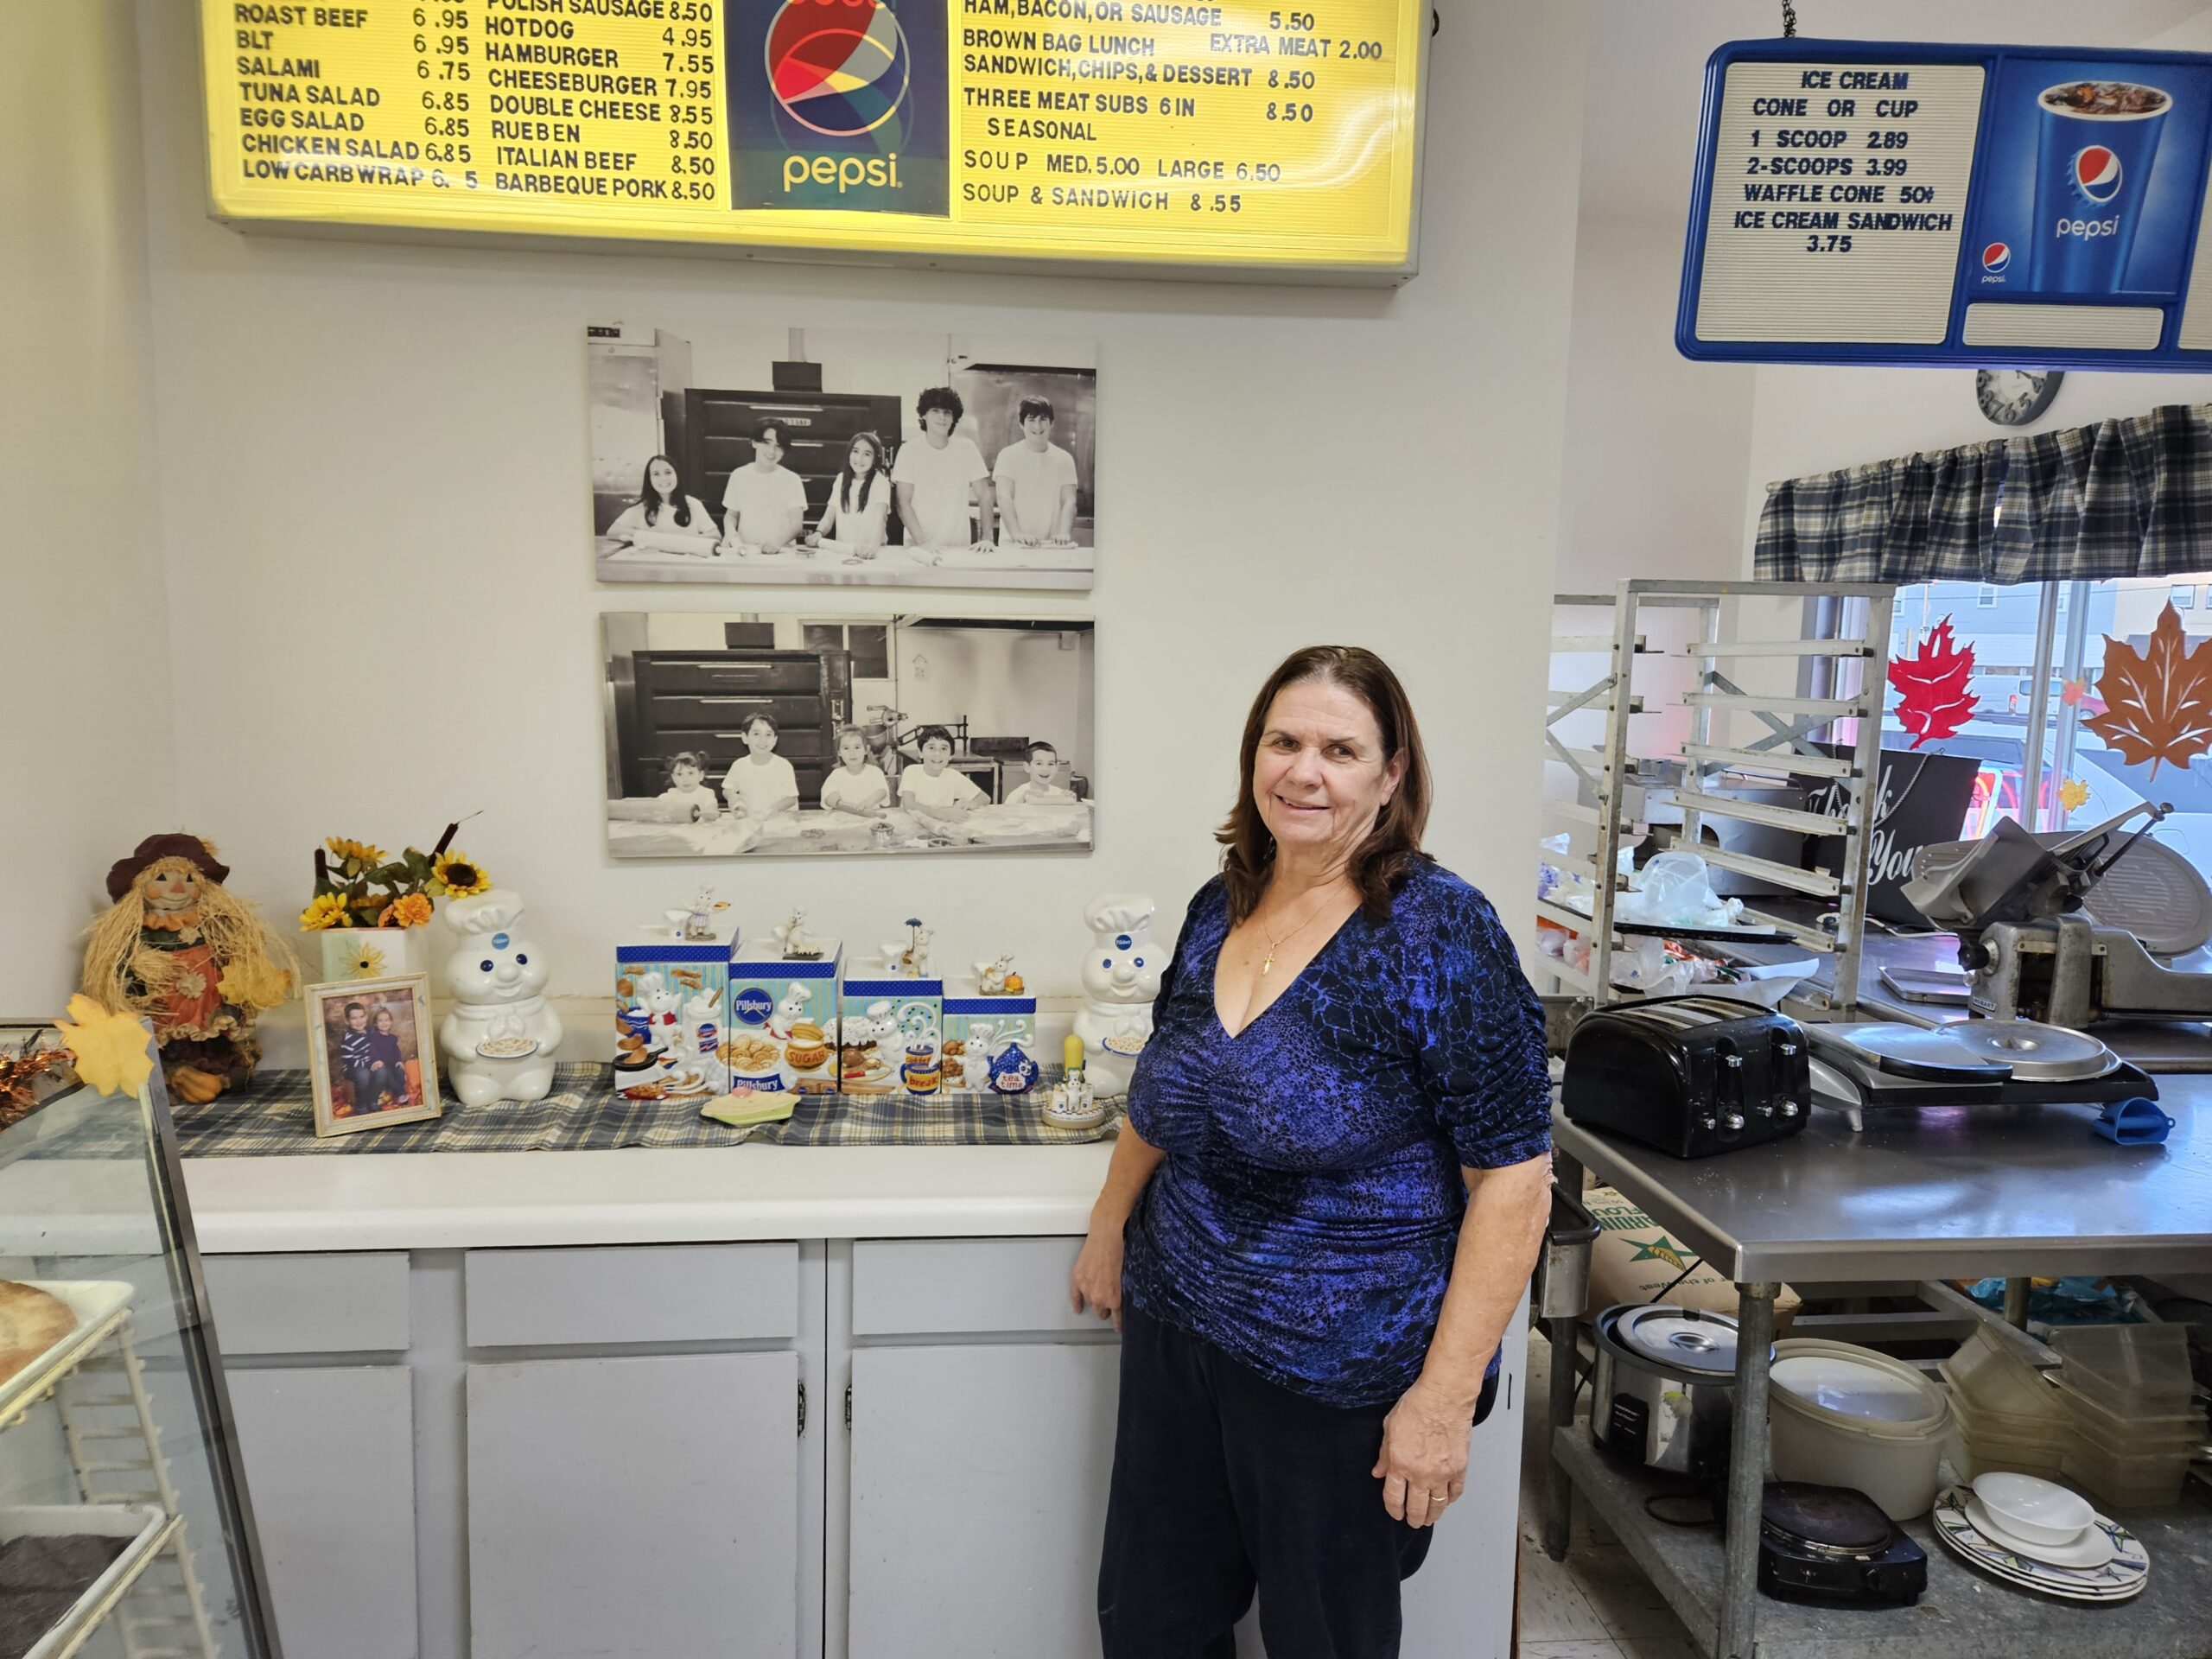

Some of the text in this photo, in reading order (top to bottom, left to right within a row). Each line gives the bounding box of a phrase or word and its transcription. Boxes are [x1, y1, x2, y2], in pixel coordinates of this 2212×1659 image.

[234, 3, 307, 25] ROAST
[314, 8, 368, 28] BEEF
[569, 0, 664, 19] SAUSAGE
[669, 1, 713, 22] 8.50
[1131, 3, 1221, 26] SAUSAGE
[1269, 11, 1314, 31] 5.50
[236, 29, 274, 50] BLT
[485, 16, 711, 48] HOTDOG 4.95
[963, 29, 1154, 56] BROWN BAG LUNCH
[486, 41, 714, 74] HAMBURGER 7.55
[1211, 33, 1382, 60] EXTRA MEAT 2.00
[236, 56, 320, 78] SALAMI
[1163, 64, 1252, 86] DESSERT
[1268, 69, 1314, 89] 8.50
[1801, 70, 1909, 90] ICE CREAM
[239, 82, 469, 111] TUNA SALAD 6.85
[488, 68, 711, 99] CHEESEBURGER 7.95
[490, 94, 713, 125] DOUBLE CHEESE 8.55
[963, 87, 1031, 108] THREE
[1038, 92, 1090, 111] MEAT
[1096, 94, 1148, 114] SUBS
[1266, 102, 1313, 123] 8.50
[1752, 98, 1919, 118] CONE OR CUP
[240, 107, 470, 137] EGG SALAD 6.85
[492, 120, 713, 149] RUEBEN 8.50
[988, 118, 1097, 141] SEASONAL
[241, 133, 471, 163] CHICKEN SALAD 6.85
[1751, 130, 1760, 148] 1
[1777, 130, 1847, 149] SCOOP
[243, 159, 290, 180] LOW
[295, 162, 353, 182] CARB
[357, 165, 424, 187] WRAP
[497, 146, 715, 176] ITALIAN BEEF 8.50
[783, 152, 897, 193] pepsi
[964, 149, 1028, 170] SOUP
[1158, 159, 1224, 180] LARGE
[1236, 162, 1281, 181] 6.50
[1746, 156, 1908, 176] 2-SCOOPS 3.99
[495, 172, 715, 200] BARBEQUE PORK 8.50
[963, 183, 1019, 203] SOUP
[1031, 186, 1043, 205] &
[1052, 187, 1168, 210] SANDWICH
[1744, 183, 1935, 204] WAFFLE CONE 50¢
[1734, 211, 1953, 231] ICE CREAM SANDWICH
[2056, 214, 2120, 242] pepsi
[1807, 234, 1853, 252] 3.75
[736, 1000, 772, 1013] Pillsbury
[788, 1051, 825, 1063] SUGAR
[736, 1077, 779, 1091] Pillsbury
[1592, 1206, 1643, 1217] FLOU
